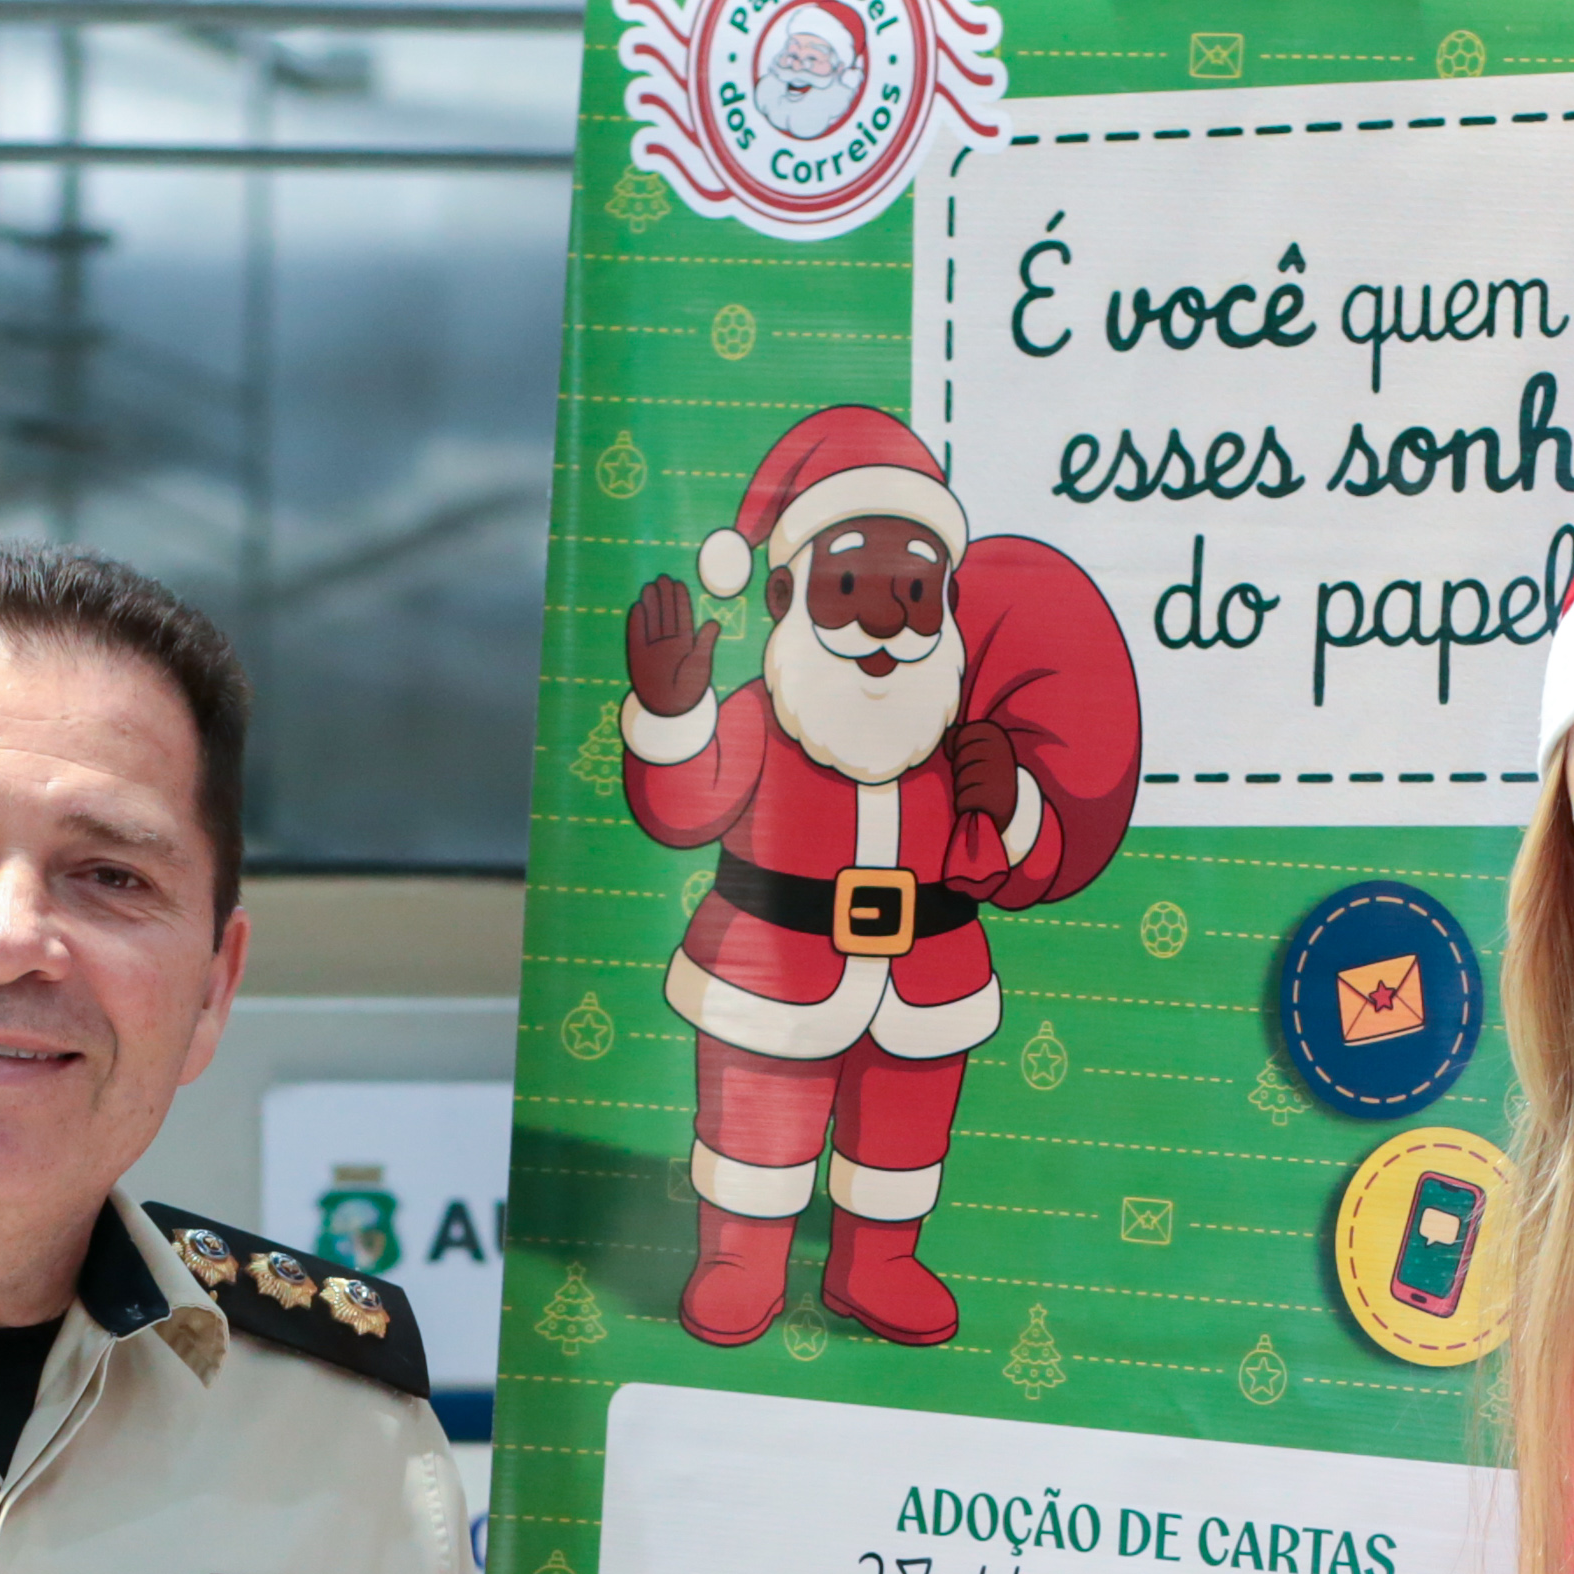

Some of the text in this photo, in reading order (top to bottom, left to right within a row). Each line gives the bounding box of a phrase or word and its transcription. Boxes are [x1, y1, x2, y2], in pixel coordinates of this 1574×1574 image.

[719, 81, 901, 183] dos Correios
[1011, 210, 1073, 357] É
[1104, 242, 1316, 352] você
[1341, 273, 1569, 393] quem
[1053, 424, 1305, 503] esses
[1153, 534, 1280, 650] do
[896, 1485, 1102, 1556] ADOÇÃO
[1118, 1508, 1182, 1563] DE
